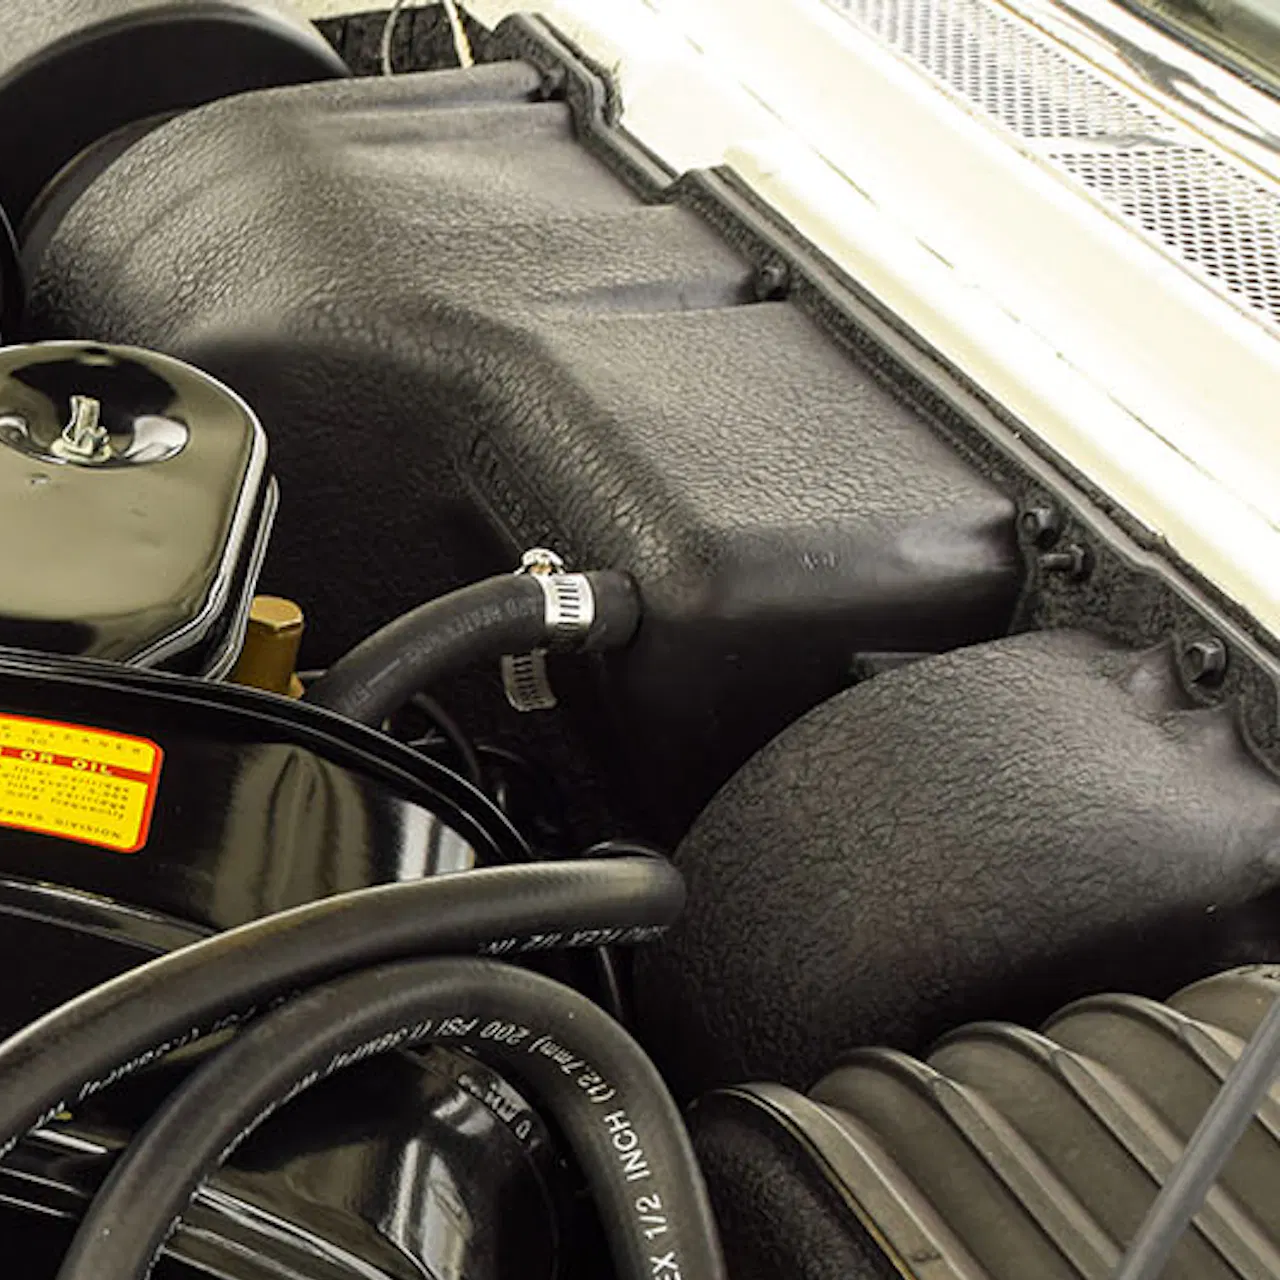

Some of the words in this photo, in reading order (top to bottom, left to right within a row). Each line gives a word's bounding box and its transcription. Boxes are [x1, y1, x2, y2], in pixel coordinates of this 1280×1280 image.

[20, 751, 54, 765] OR
[71, 758, 113, 776] OIL
[435, 1016, 479, 1039] PSI
[480, 1020, 531, 1047] 200
[604, 1108, 652, 1182] INCH
[635, 1192, 669, 1240] 1/2
